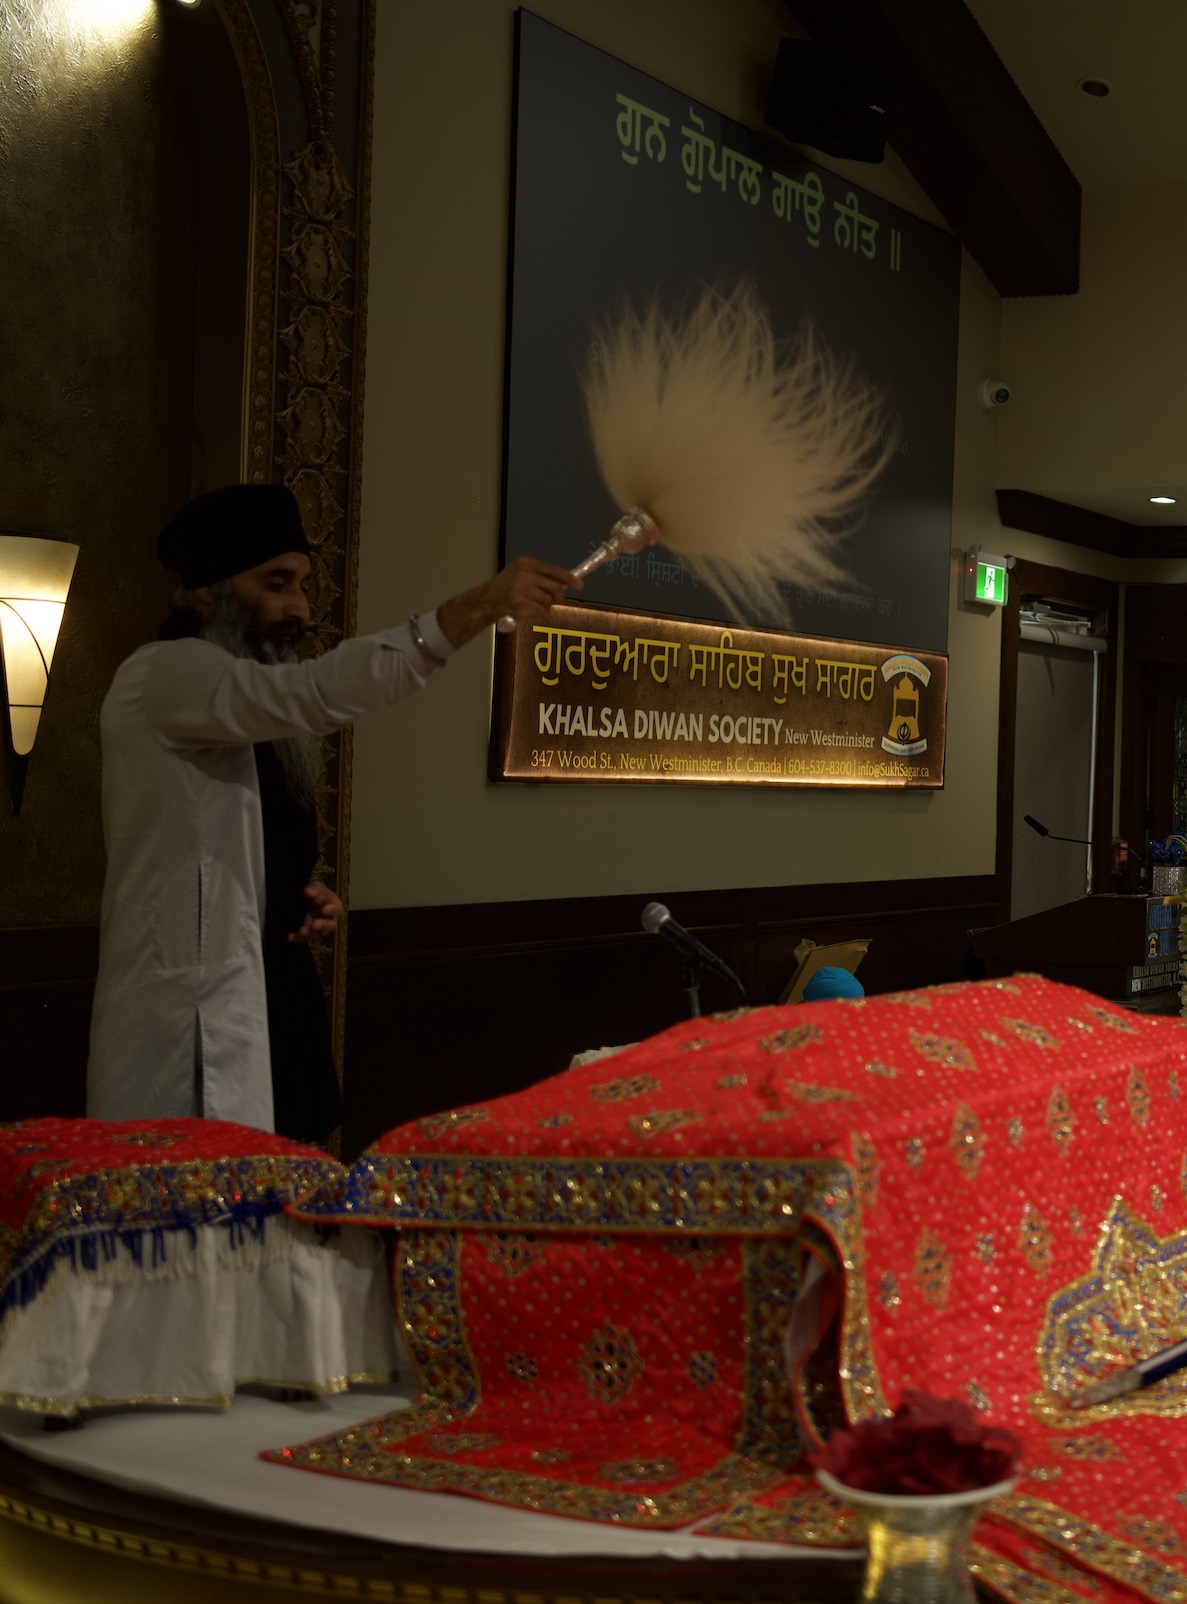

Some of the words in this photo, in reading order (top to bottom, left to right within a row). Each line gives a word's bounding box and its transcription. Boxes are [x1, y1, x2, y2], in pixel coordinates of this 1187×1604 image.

[616, 93, 670, 165] ਗੁਨ
[772, 171, 825, 247] ਗਾਉ
[834, 191, 879, 260] ਨੀਤ
[533, 625, 681, 690] ਗੁਰਦੁਆਰਾ
[689, 631, 765, 692] ਸਾਹਿਬ
[772, 654, 810, 704] ਸੁਖ
[815, 659, 877, 701] ਸਾਗਰ
[538, 702, 629, 739] KHALSA
[634, 709, 703, 742] DIWAN
[708, 713, 784, 745] SOCIETY
[785, 728, 808, 745] New
[810, 730, 875, 748] Westminister
[530, 749, 554, 768] 347
[557, 750, 597, 769] Wood
[600, 752, 617, 771] St.,
[620, 753, 646, 770] New
[650, 754, 724, 774] Westminister,
[747, 757, 782, 774] Canada
[788, 759, 852, 776] 604-537-8300
[858, 761, 930, 781] info@SukhSagar.ca
